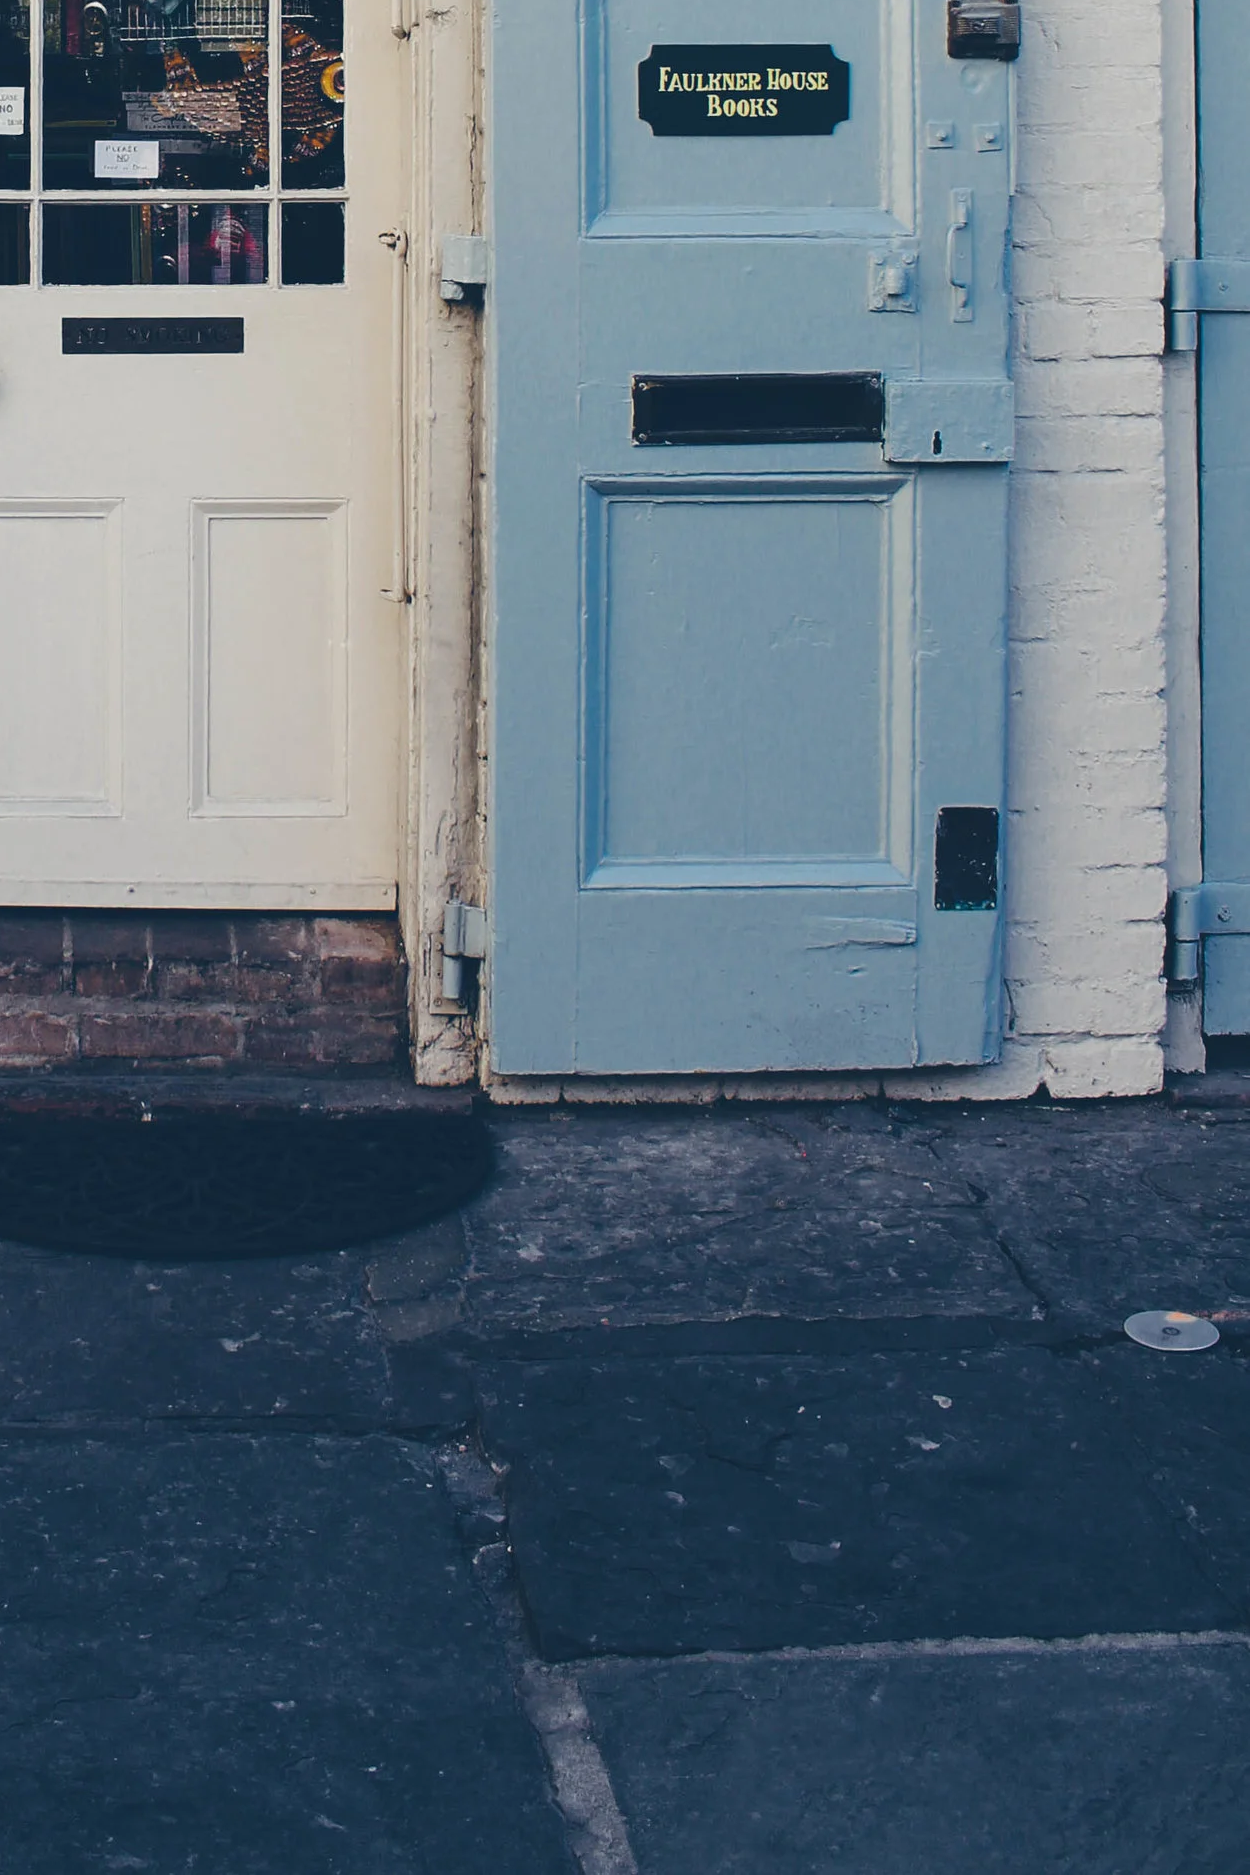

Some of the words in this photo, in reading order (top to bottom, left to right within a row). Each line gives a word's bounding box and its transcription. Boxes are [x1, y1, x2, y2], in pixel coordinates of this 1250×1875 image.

[658, 66, 762, 92] FAULKNER
[766, 68, 829, 91] HOUSE
[706, 94, 778, 117] BOOKS
[116, 154, 130, 162] NO
